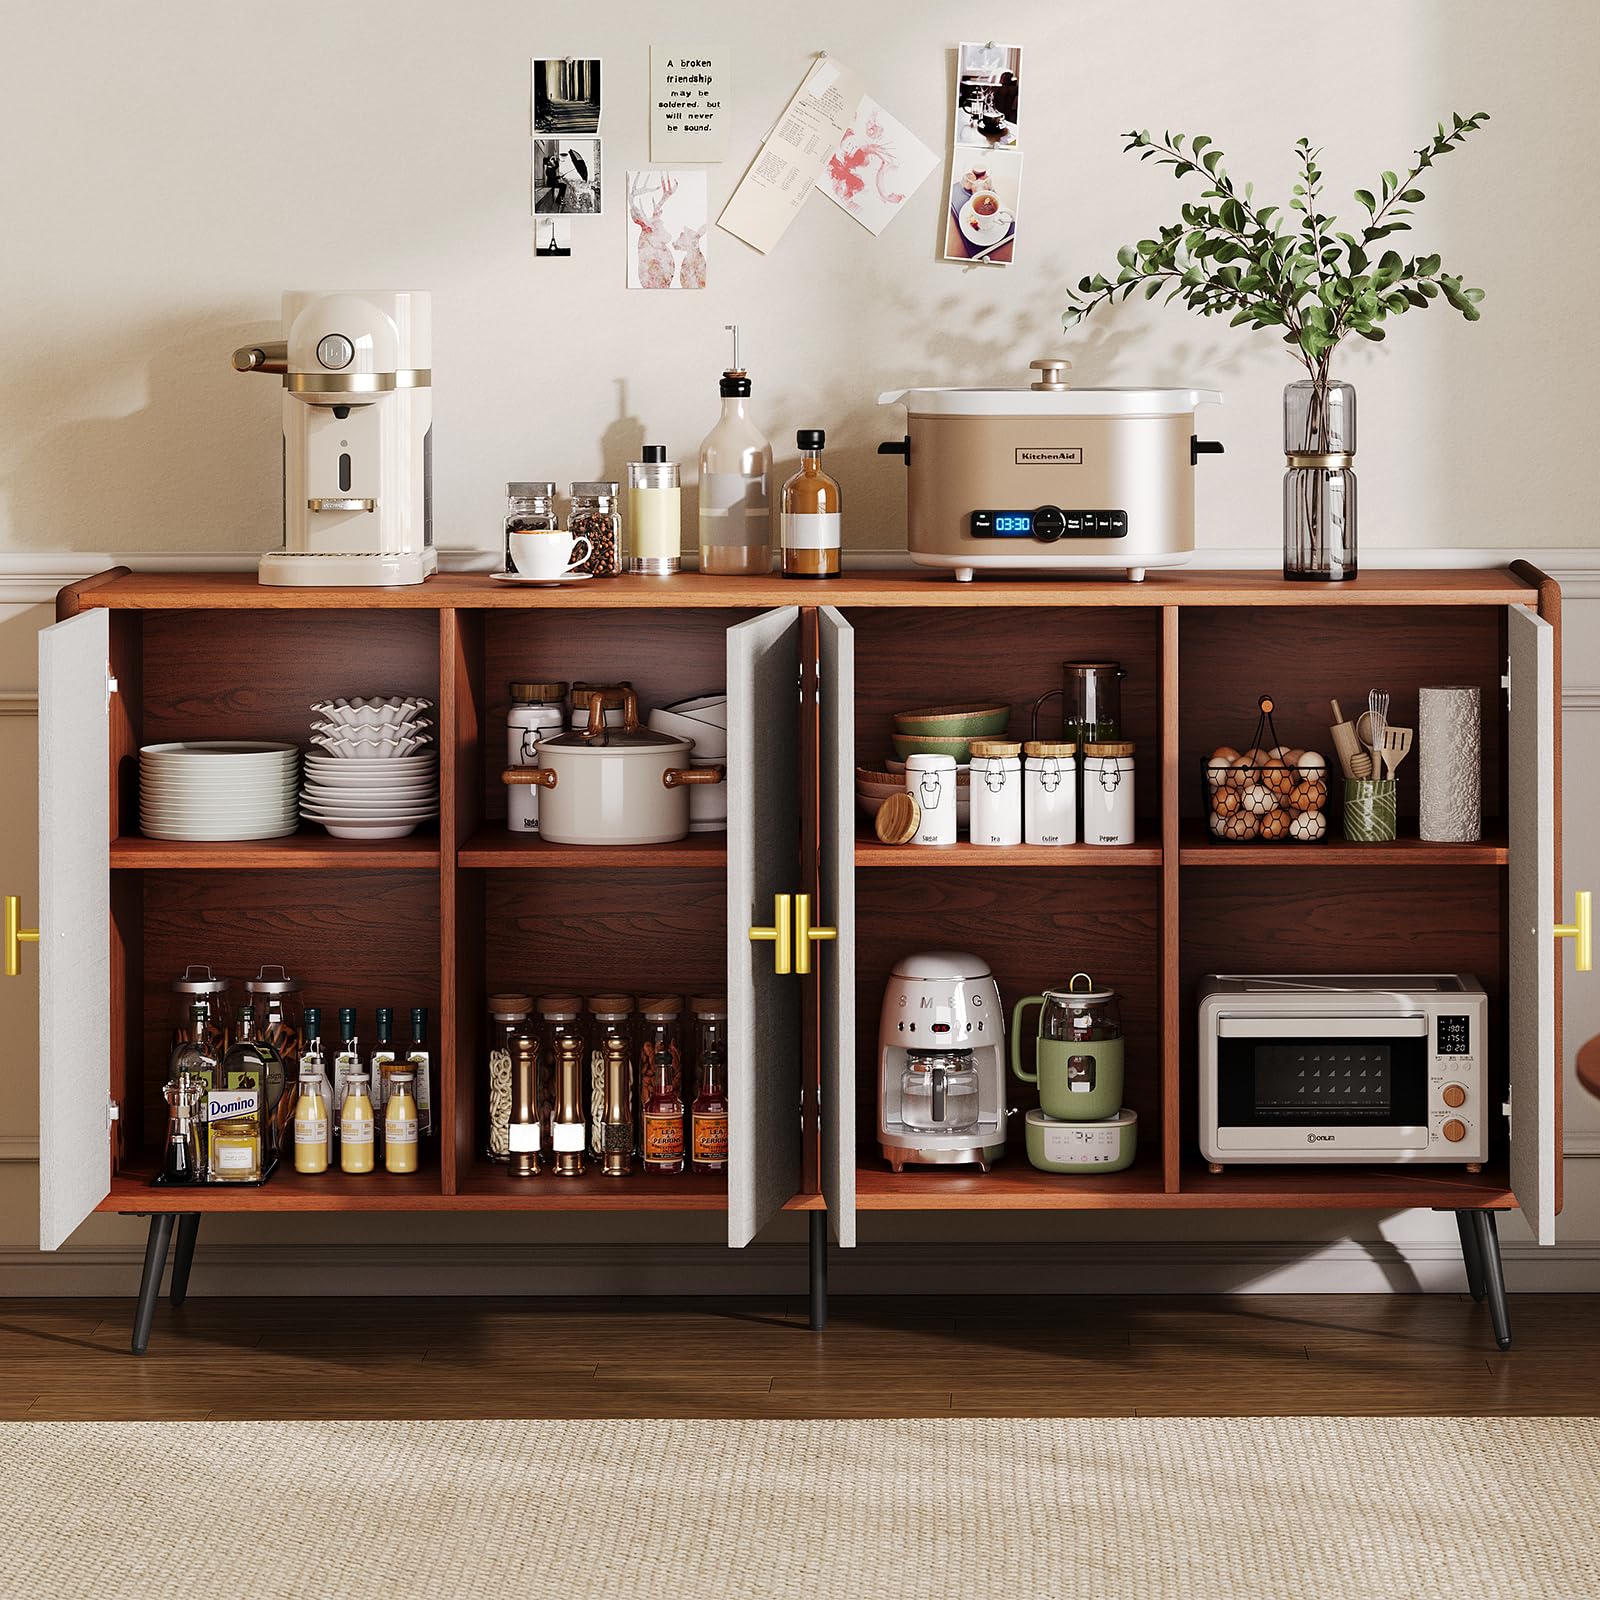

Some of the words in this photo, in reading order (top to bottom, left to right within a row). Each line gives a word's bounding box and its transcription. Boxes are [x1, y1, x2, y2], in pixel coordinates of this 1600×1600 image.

[666, 74, 713, 85] friendship
[996, 517, 1030, 531] 03:30
[209, 1098, 255, 1116] Domino
